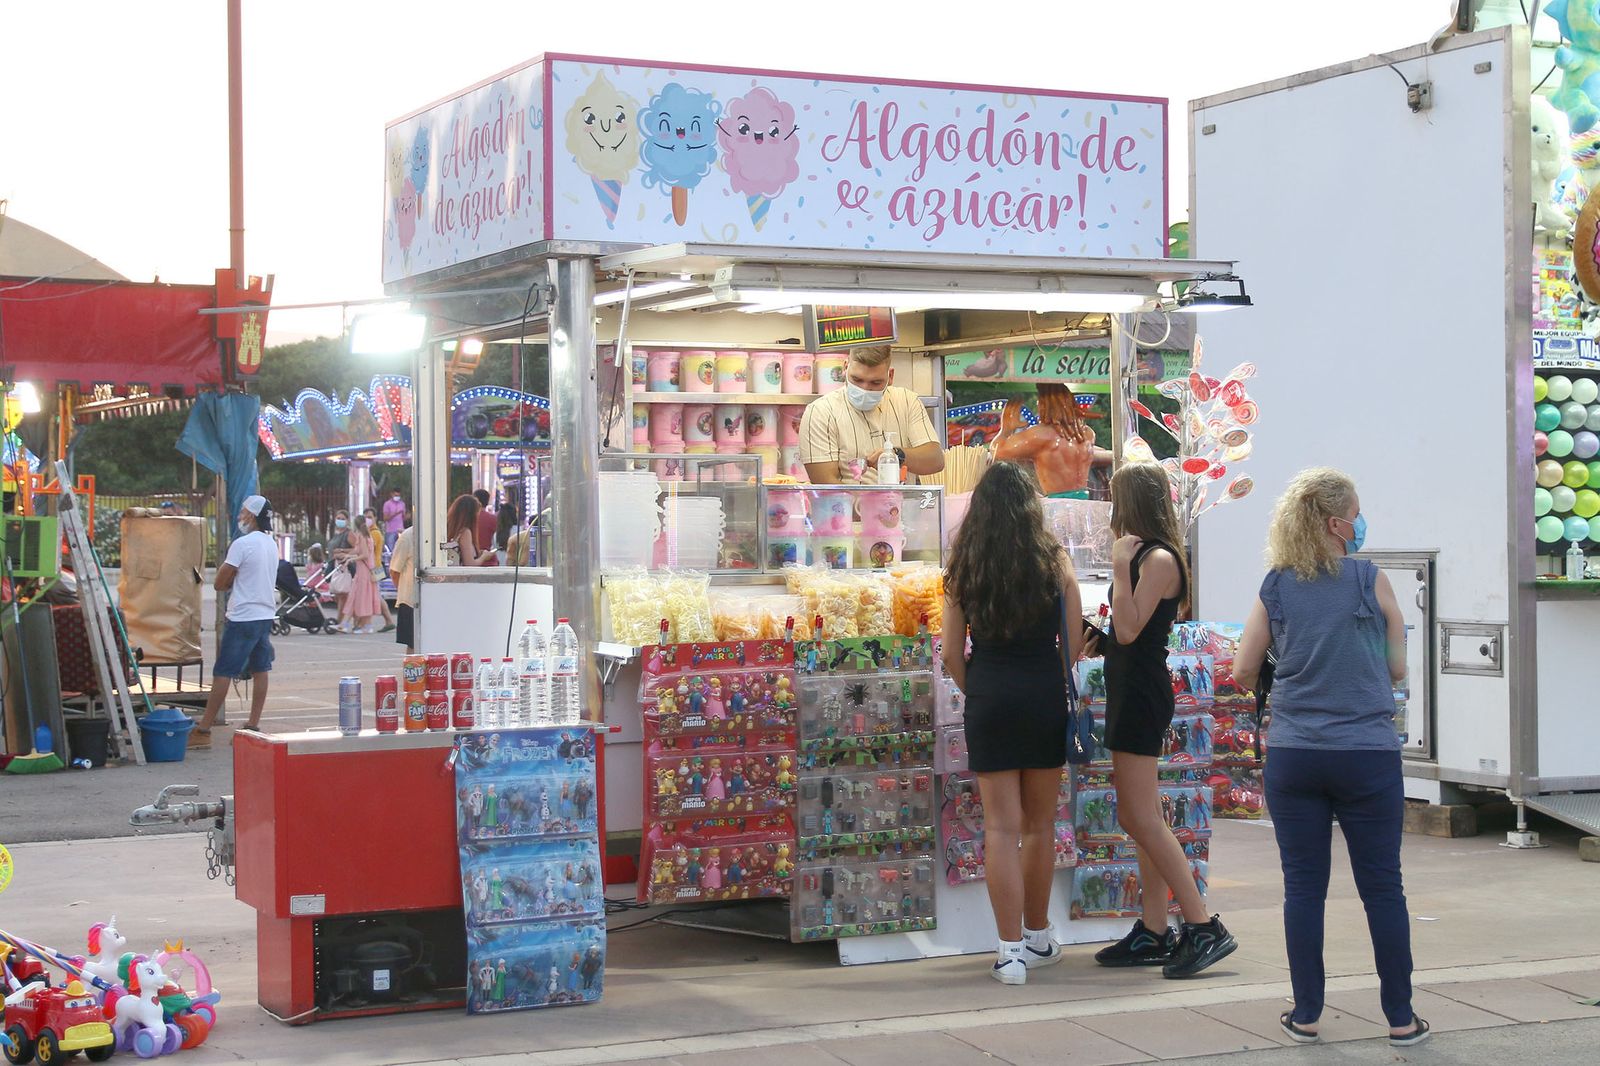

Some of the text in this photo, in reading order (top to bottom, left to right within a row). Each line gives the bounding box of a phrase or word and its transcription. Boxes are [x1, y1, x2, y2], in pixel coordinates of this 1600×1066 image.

[442, 93, 526, 178] Algodón
[821, 100, 1138, 182] Algodón de
[434, 150, 533, 240] de azúcar!
[888, 172, 1087, 241] azúcar!
[1022, 348, 1110, 375] la selva
[502, 745, 558, 764] FROZEN
